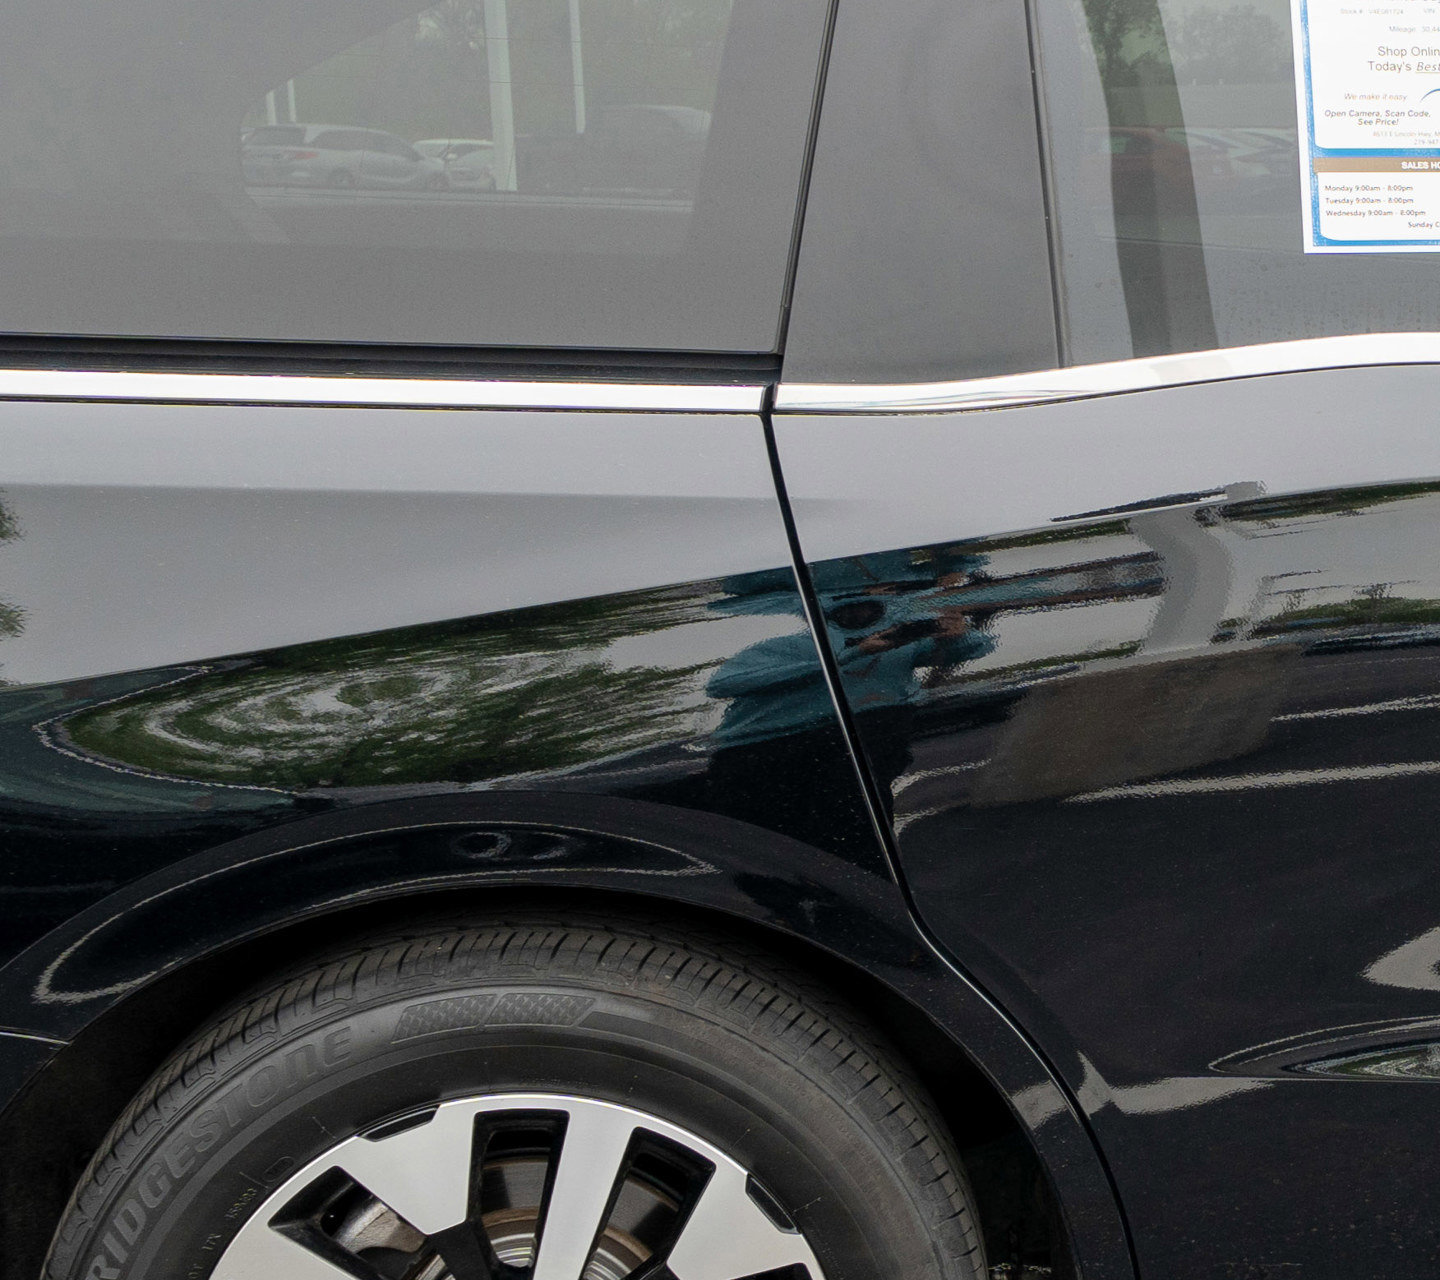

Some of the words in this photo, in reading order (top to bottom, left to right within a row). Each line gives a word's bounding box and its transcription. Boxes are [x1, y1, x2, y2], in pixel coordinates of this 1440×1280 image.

[1377, 46, 1408, 58] Shop
[1367, 61, 1412, 73] Today's
[1324, 110, 1347, 119] Open
[1348, 109, 1383, 118] Camera,
[1385, 110, 1406, 118] Scan
[1407, 110, 1431, 118] Code,
[1357, 118, 1374, 126] See
[1375, 118, 1399, 126] Price!
[1401, 161, 1429, 170] SALES
[1324, 184, 1353, 193] Monday
[1325, 197, 1354, 205] Tuesday
[1326, 209, 1366, 218] Wednesday
[1407, 221, 1434, 229] Sunday
